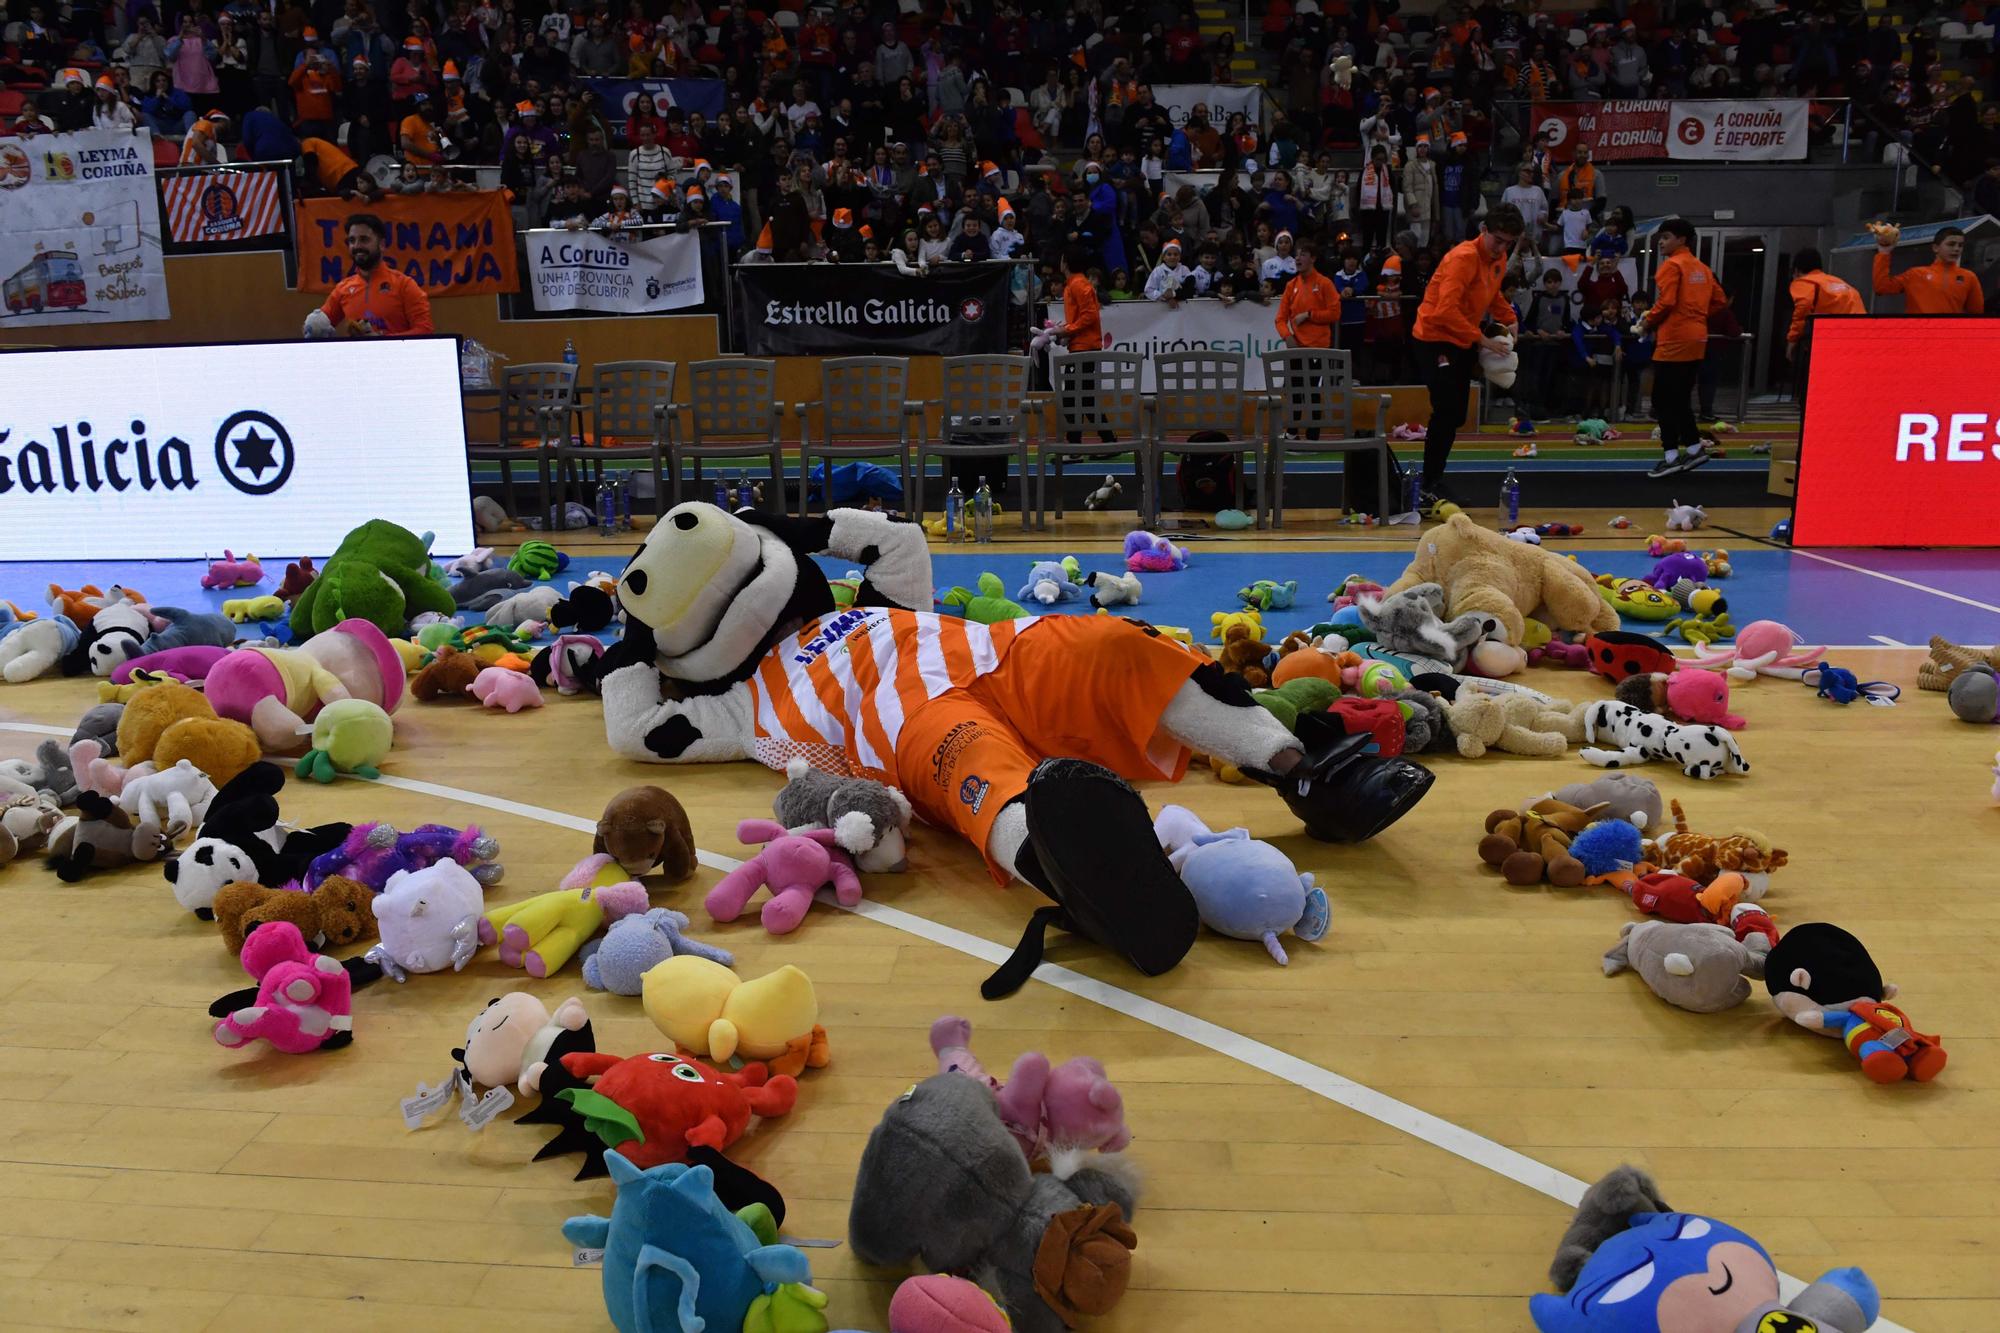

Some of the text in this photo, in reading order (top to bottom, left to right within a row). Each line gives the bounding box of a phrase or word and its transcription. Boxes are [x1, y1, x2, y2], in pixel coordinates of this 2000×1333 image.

[1714, 109, 1783, 127] A CORUÑA
[1597, 127, 1664, 147] A CORUÑA
[1714, 127, 1786, 146] É DEPORTE
[78, 147, 138, 163] LEYMA
[82, 160, 147, 180] CORUÑA
[541, 245, 630, 266] A Coruña
[537, 271, 634, 286] UNHA PROVINCIA
[542, 283, 630, 298] POR DESCUBRIR
[763, 298, 951, 325] Estrella Galicia
[1895, 413, 2000, 462] RE
